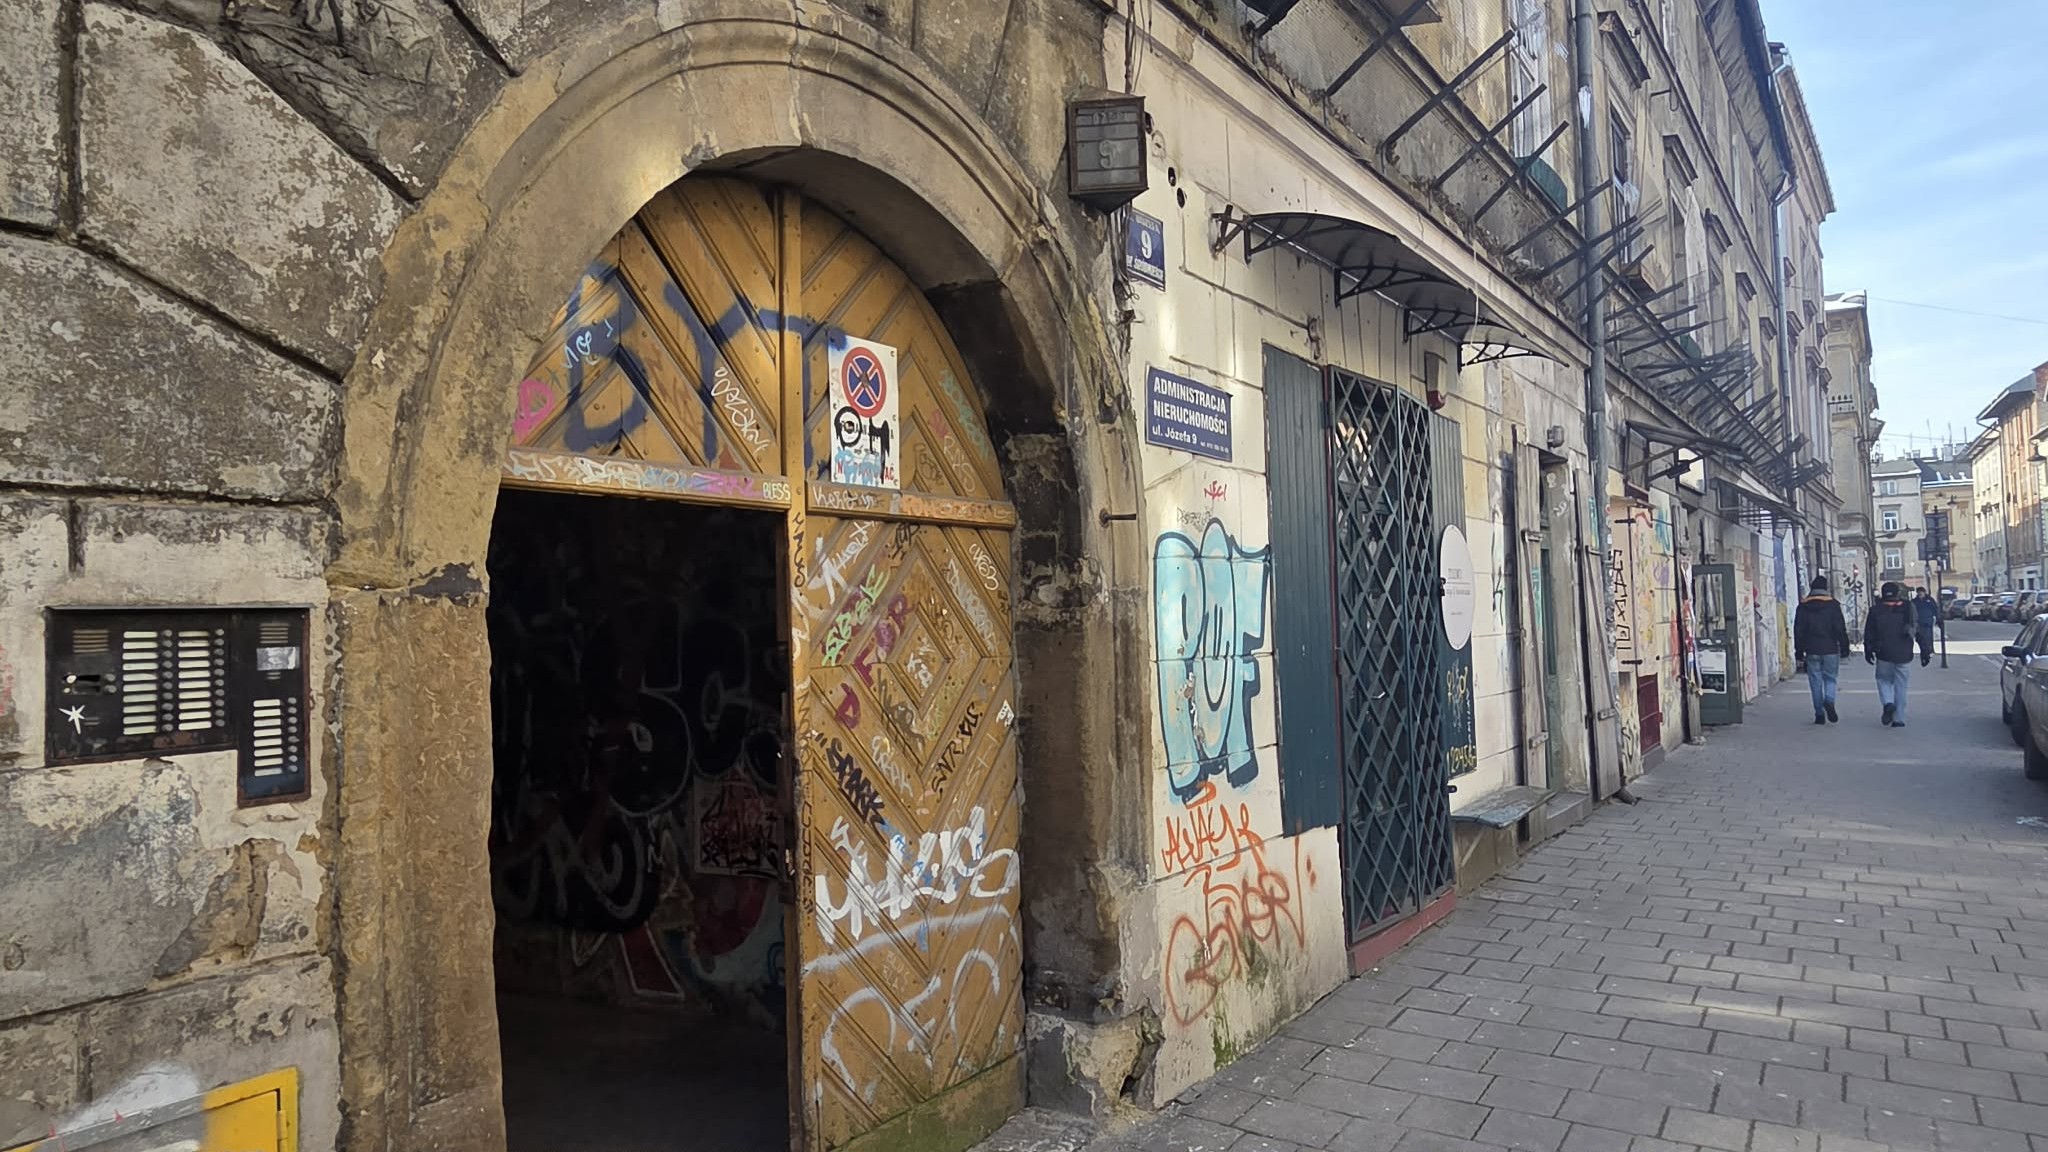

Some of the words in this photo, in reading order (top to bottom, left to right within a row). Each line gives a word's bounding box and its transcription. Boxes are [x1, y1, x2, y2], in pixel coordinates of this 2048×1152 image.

[1141, 230, 1153, 259] 9
[1153, 376, 1227, 415] ADMINISTRACJA
[1153, 398, 1228, 436] NIERUCHOMOŚCI
[1152, 423, 1164, 437] ul.
[1164, 425, 1191, 443] Józefa
[1191, 433, 1198, 444] 9
[762, 481, 792, 501] BLESS
